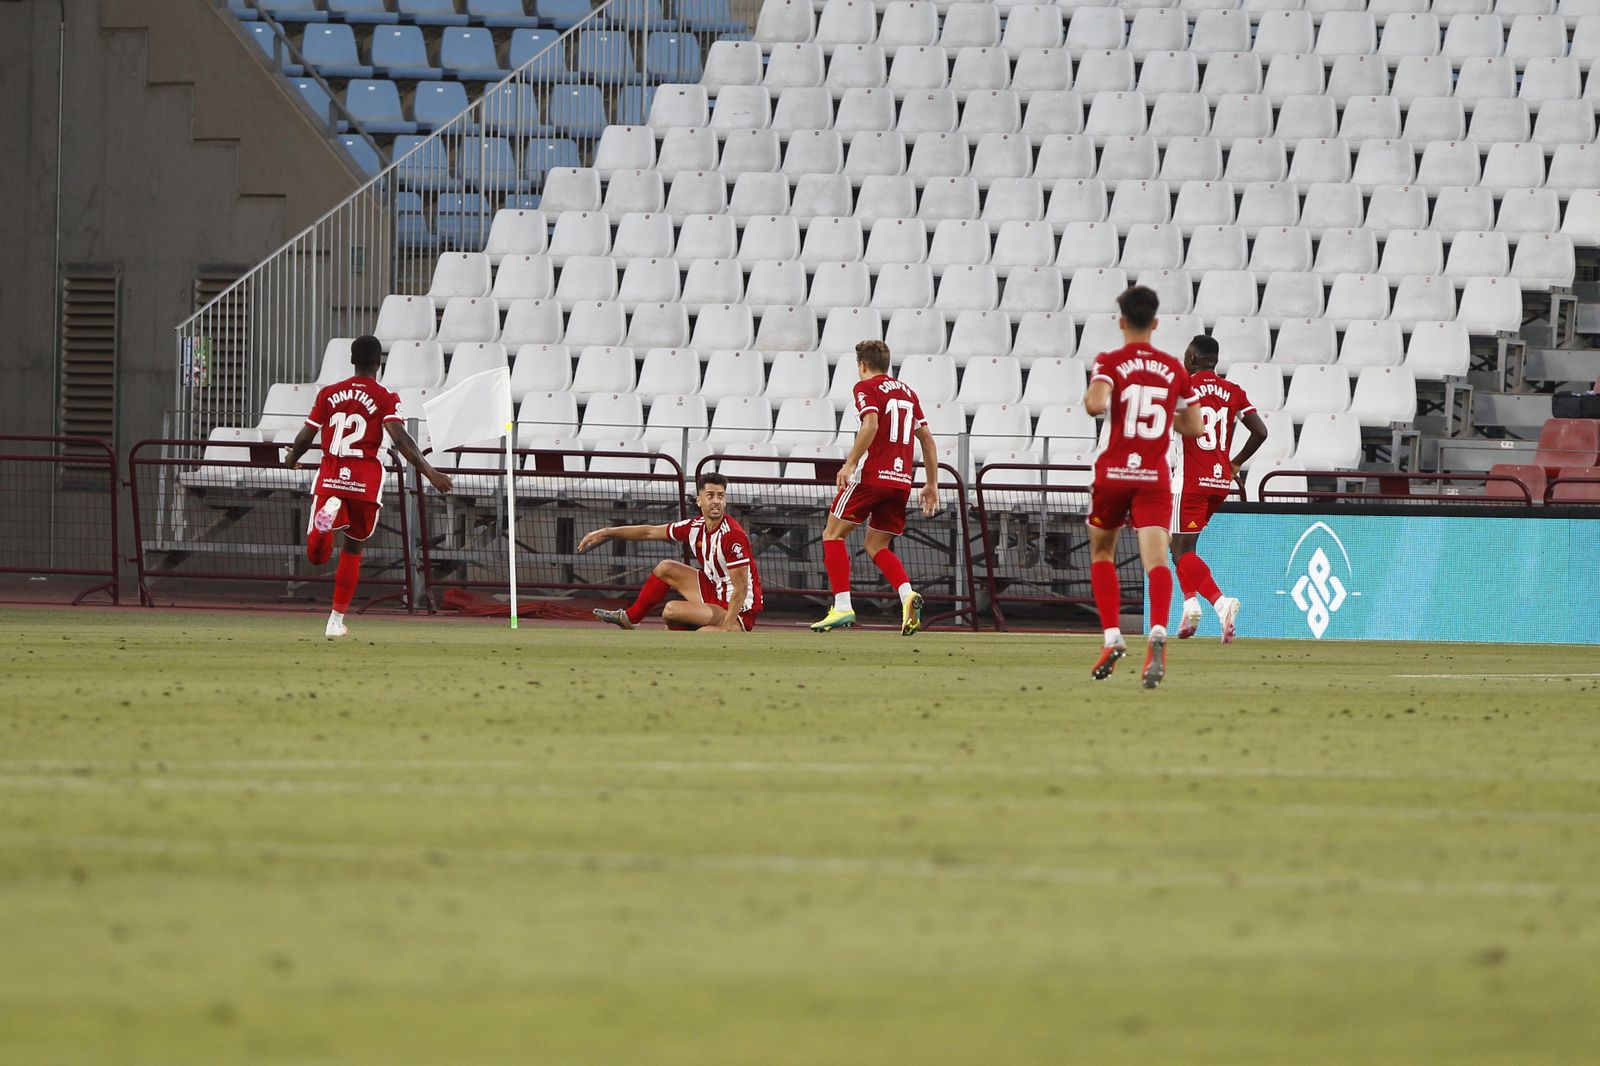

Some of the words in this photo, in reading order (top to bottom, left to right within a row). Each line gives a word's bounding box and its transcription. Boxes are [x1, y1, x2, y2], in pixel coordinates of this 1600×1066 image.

[1116, 358, 1144, 379] JUAN
[1145, 359, 1175, 384] IBIZA
[1193, 384, 1231, 402] APPIAH
[327, 389, 378, 415] JONATHAN
[885, 398, 914, 445] 17
[1120, 383, 1169, 440] 15
[328, 412, 367, 458] 12
[1196, 406, 1229, 452] 31
